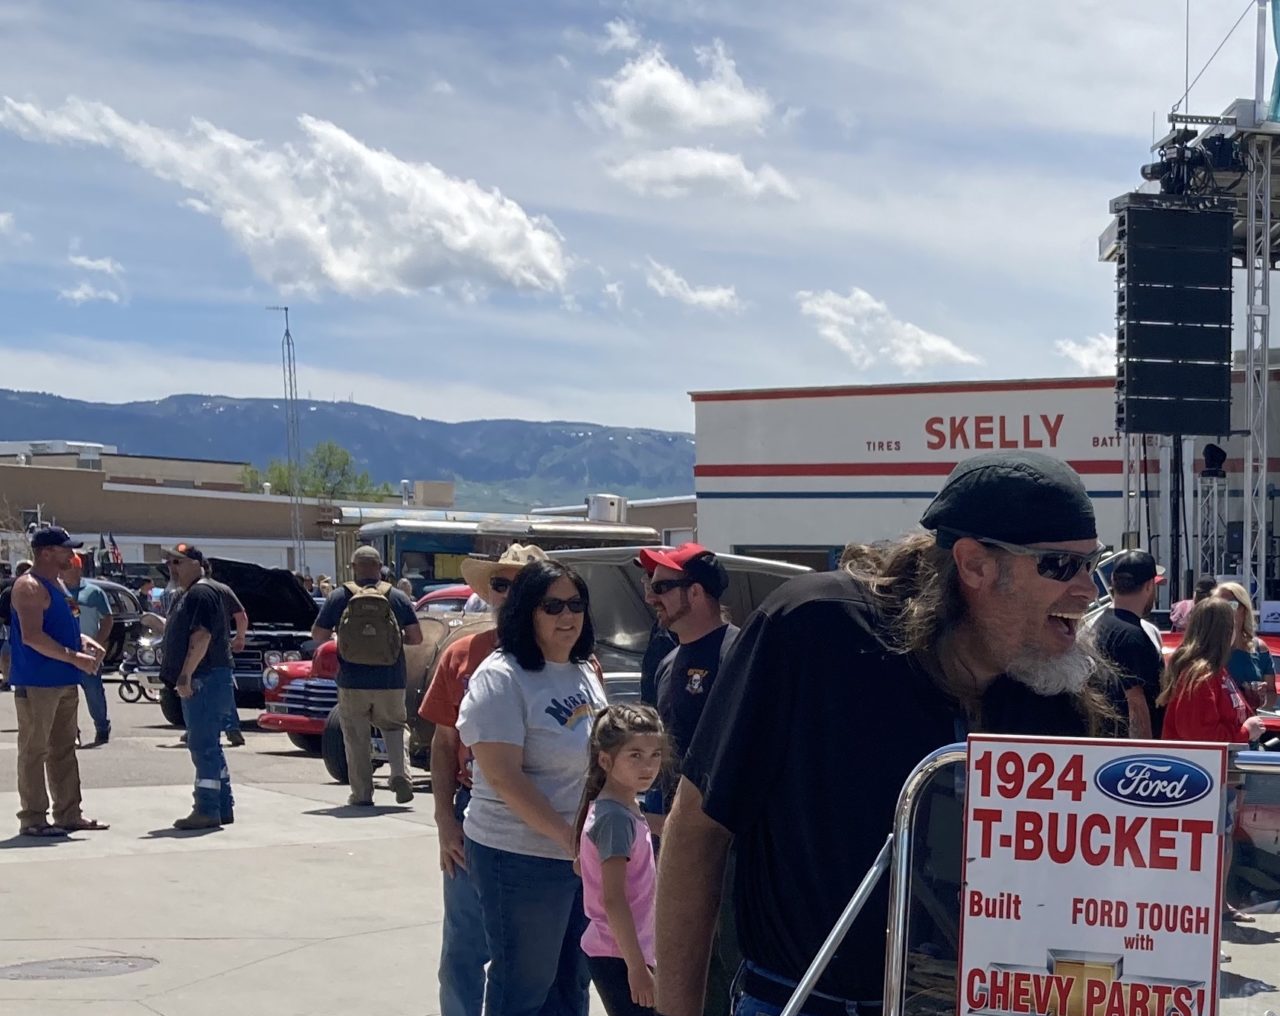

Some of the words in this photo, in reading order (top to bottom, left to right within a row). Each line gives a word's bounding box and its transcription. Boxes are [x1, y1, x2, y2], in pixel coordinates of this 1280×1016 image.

[866, 440, 901, 451] TIRES
[925, 414, 1064, 450] SKELLY
[975, 751, 1087, 801] 1924
[1117, 762, 1188, 799] Ford
[973, 808, 1213, 871] T-BUCKET
[969, 890, 1022, 920] Built
[1072, 898, 1128, 929] FORD
[1136, 902, 1210, 934] TOUGH
[1124, 934, 1154, 951] with
[967, 968, 1074, 1016] CHEVY
